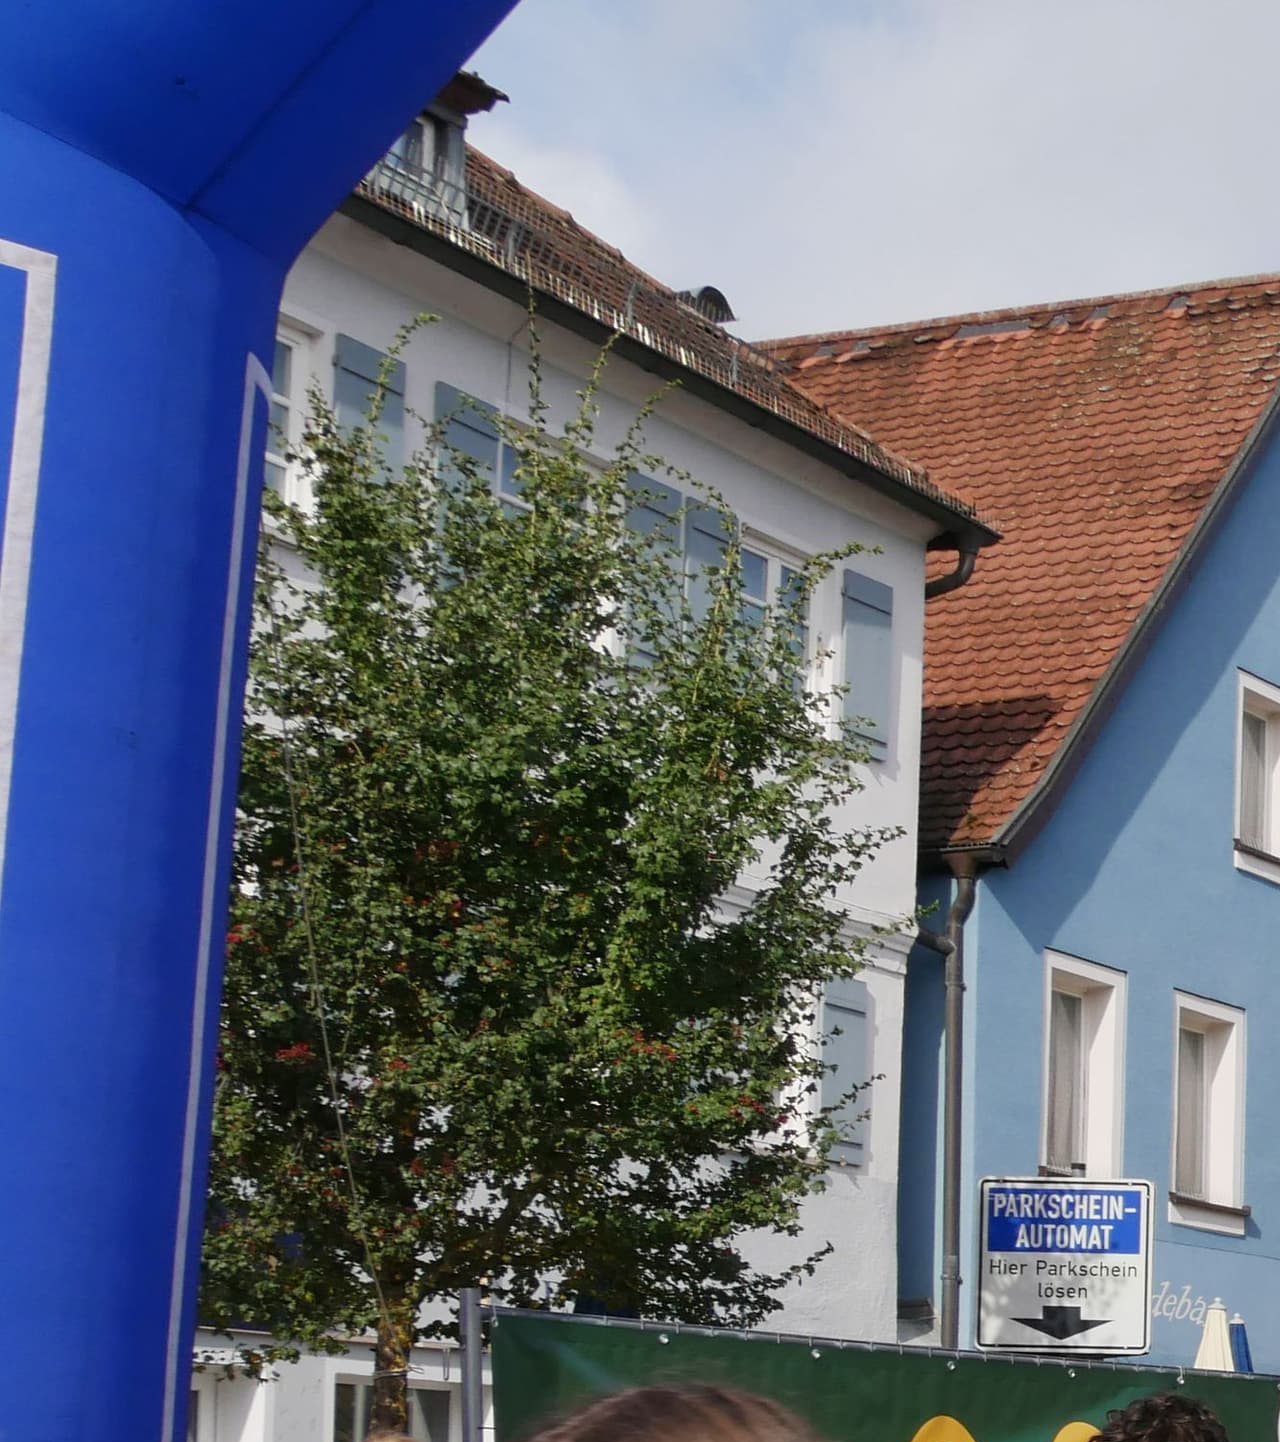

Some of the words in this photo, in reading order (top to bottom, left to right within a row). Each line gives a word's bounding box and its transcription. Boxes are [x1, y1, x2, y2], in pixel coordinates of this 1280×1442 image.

[992, 1192, 1137, 1220] PARKSCHEIN-
[1015, 1223, 1114, 1250] AUTOMAT
[989, 1259, 1028, 1276] Hier
[1036, 1260, 1138, 1277] Parkschein
[1037, 1282, 1089, 1299] lösen
